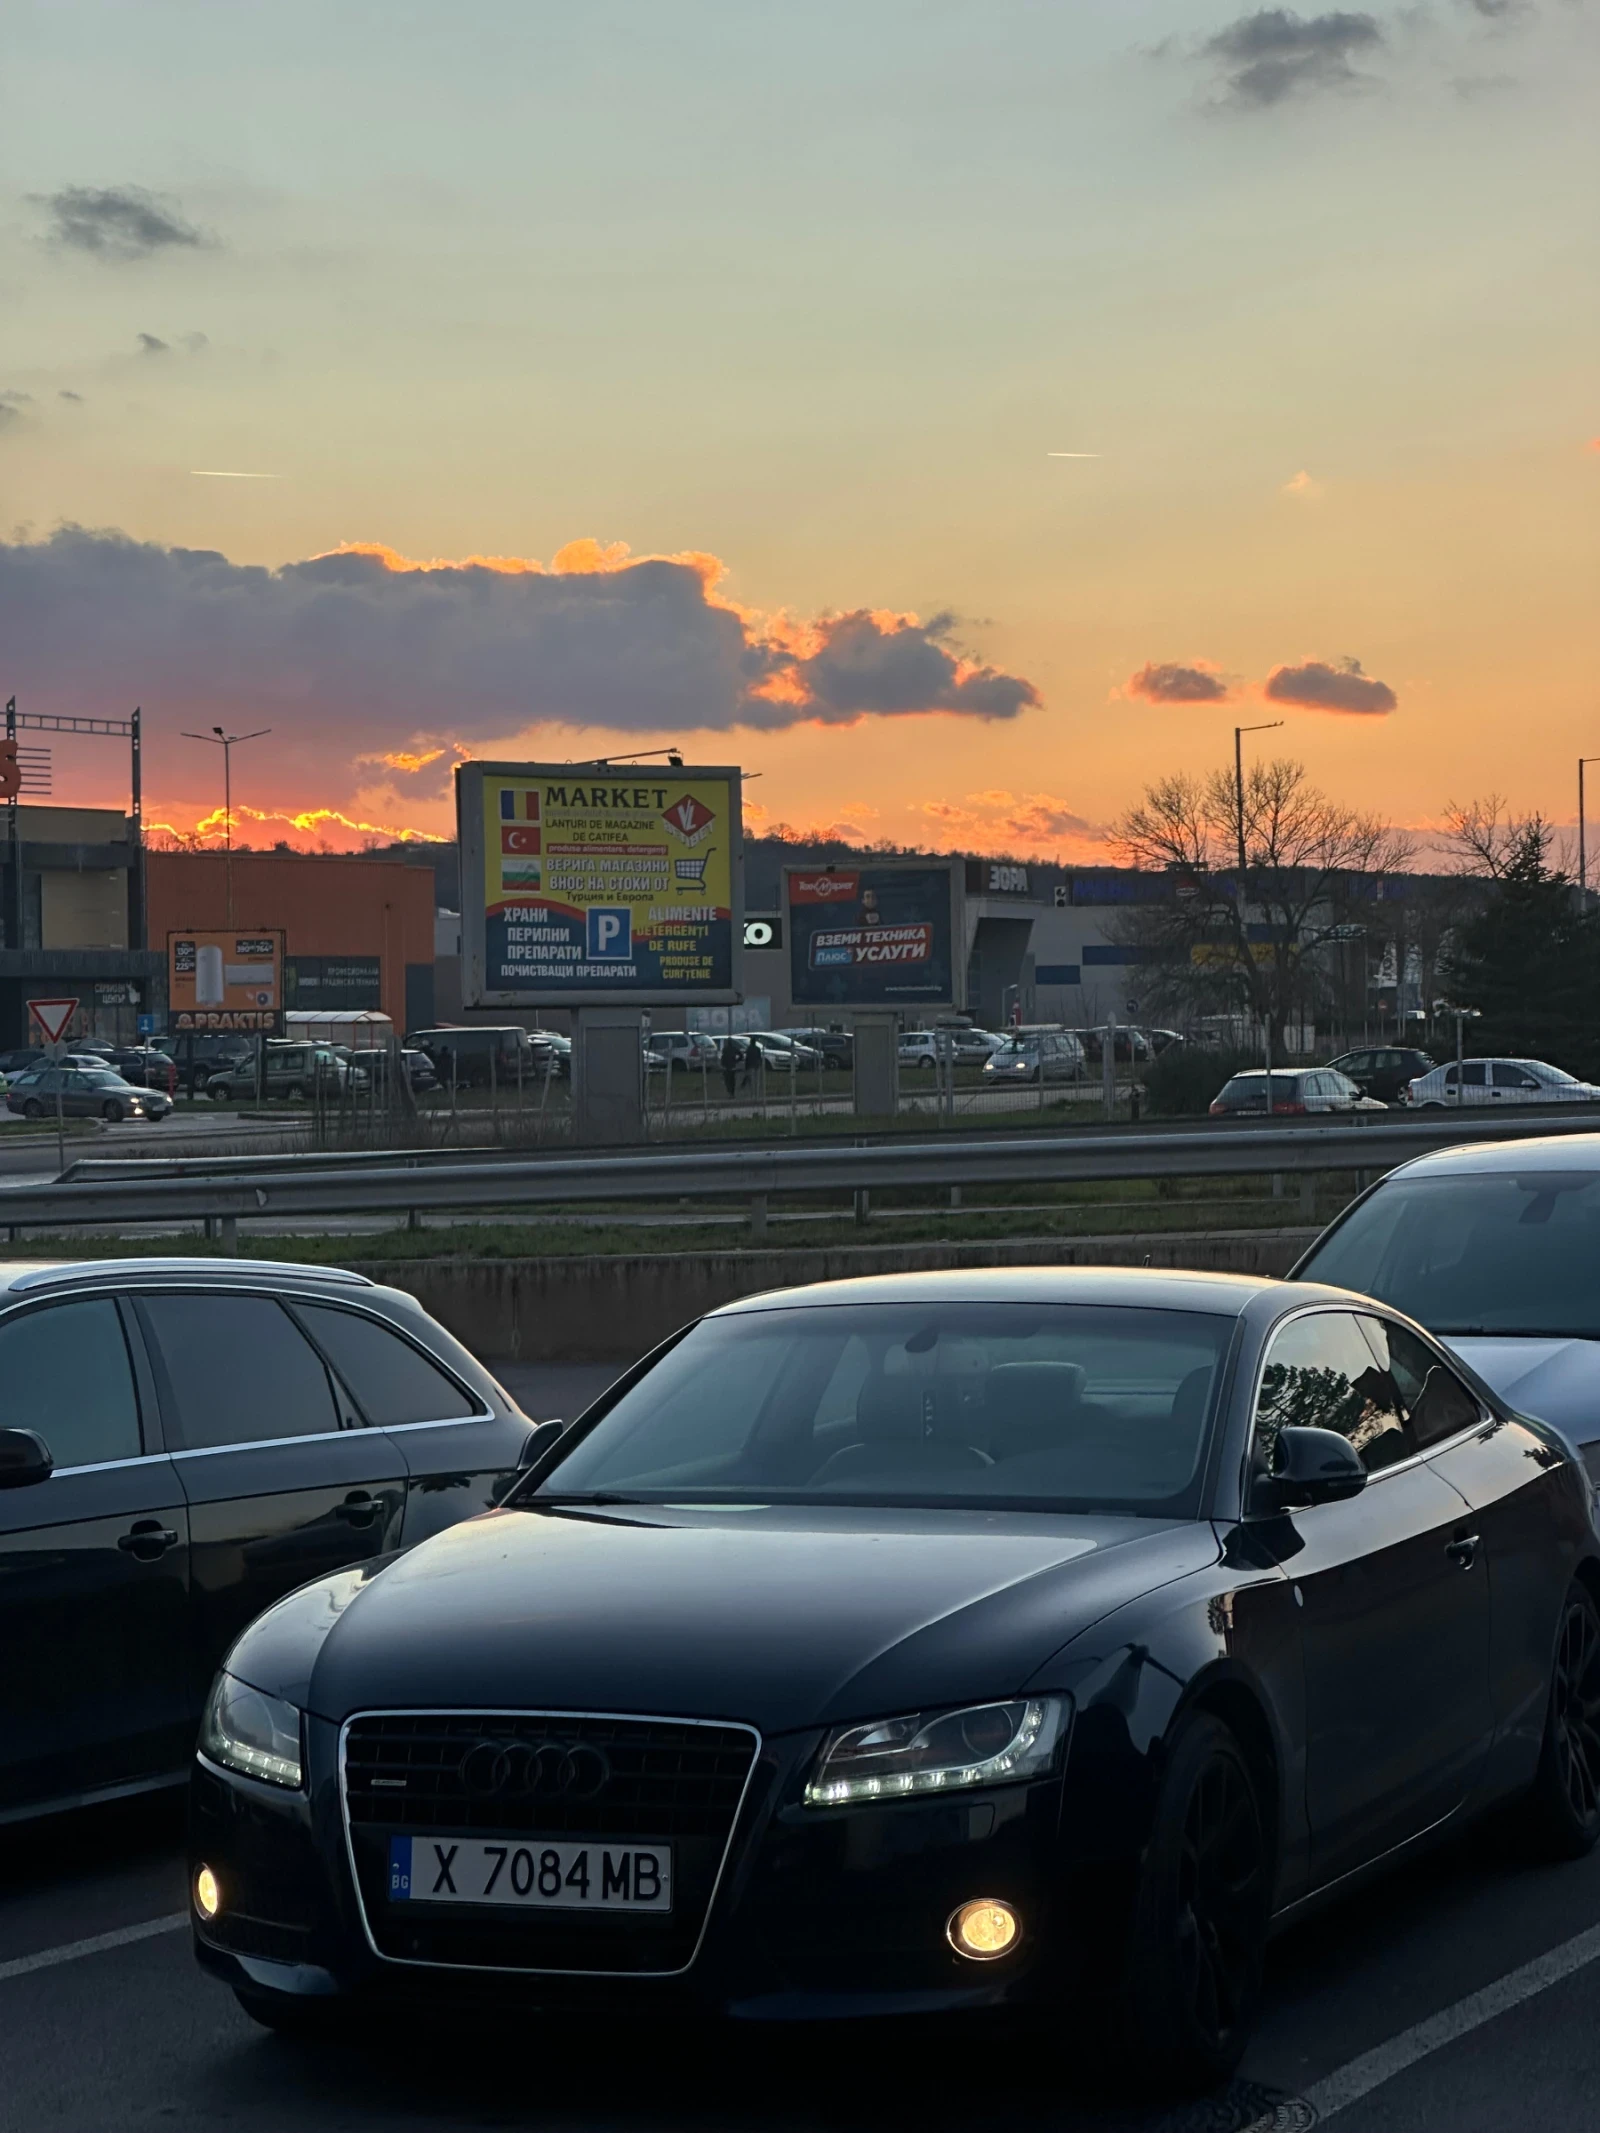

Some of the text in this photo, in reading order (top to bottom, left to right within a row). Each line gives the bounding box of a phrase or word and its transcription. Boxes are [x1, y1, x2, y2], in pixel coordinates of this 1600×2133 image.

[545, 787, 668, 809] MARKET
[589, 820, 602, 829] DE
[605, 820, 655, 830] MAGAZINE
[573, 832, 628, 842] DE CATIFEA
[547, 859, 670, 873] ВЕРИГА МАГАЗИНИ
[550, 876, 670, 892] ВНОС НА СТОКИ ОТ
[989, 865, 1029, 892] ЗОРА
[566, 891, 604, 902] Турция
[617, 892, 654, 902] Европа
[503, 907, 548, 923] ХРАНИ
[648, 906, 717, 921] ALIMENTE
[507, 927, 570, 942] ПЕРИЛНИ
[598, 915, 620, 951] P
[816, 928, 926, 947] ВЗЕМИ ТЕХНИКА
[507, 945, 582, 960] ПРЕПАРАТИ
[648, 940, 696, 951] DE RUFE
[855, 943, 926, 962] УСЛУГИ
[659, 955, 714, 966] PRODUSE DE
[500, 964, 637, 978] ПОЧИСТВАЩИ ПРЕПАРАТИ
[195, 1012, 275, 1030] PRAKTIS
[483, 1846, 590, 1899] 7084
[391, 1874, 409, 1890] BG
